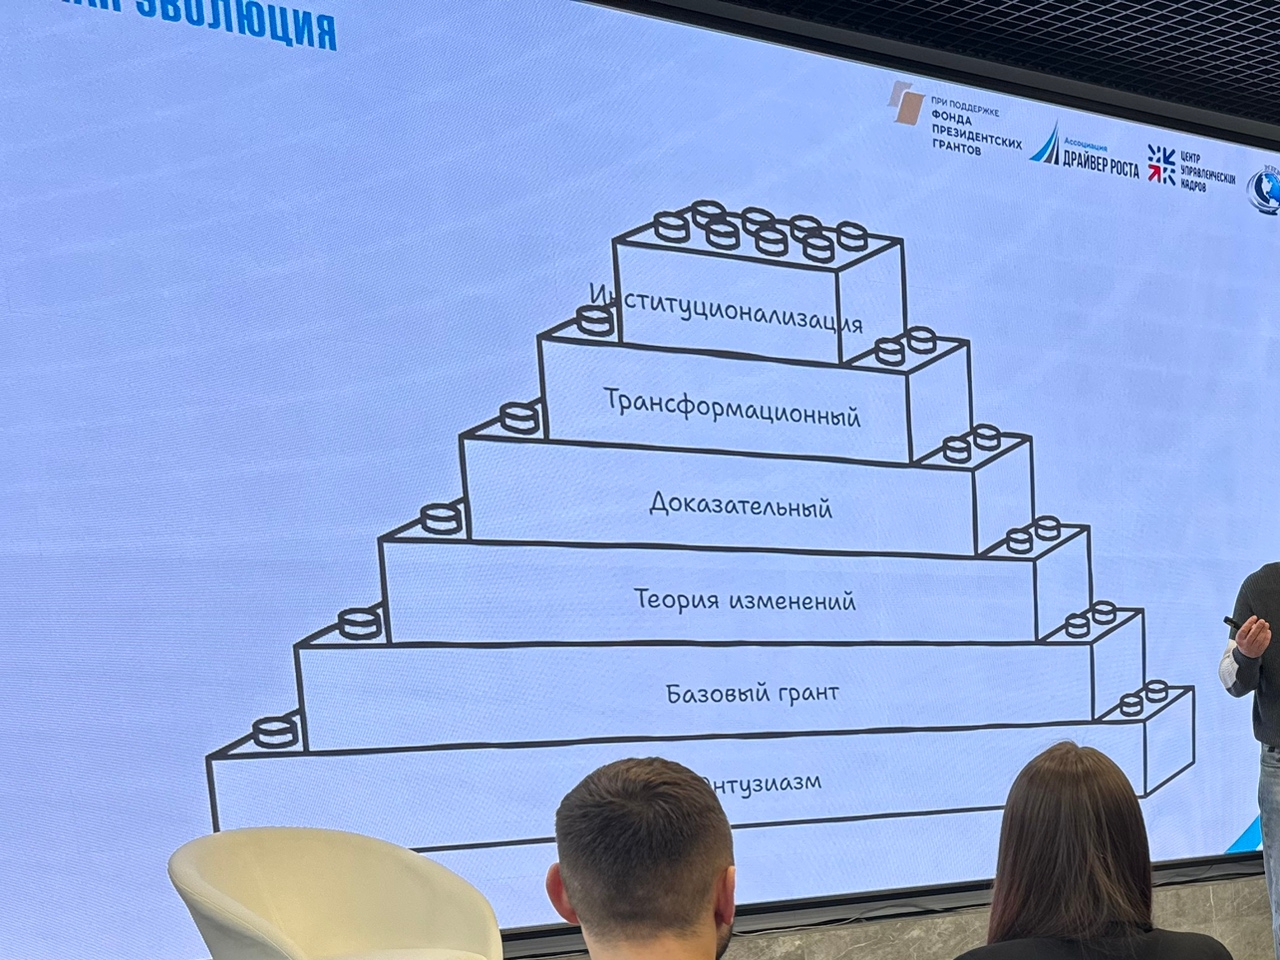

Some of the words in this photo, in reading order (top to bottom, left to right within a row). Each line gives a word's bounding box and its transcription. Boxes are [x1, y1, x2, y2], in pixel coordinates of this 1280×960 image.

[931, 96, 948, 107] ПРИ
[950, 100, 1000, 117] ПОДДЕРЖКЕ
[931, 109, 973, 126] ФОНДА
[932, 124, 1023, 150] ПРЕЗИДЕНТСКИХ
[932, 138, 982, 156] ГРАНТОВ
[1063, 149, 1109, 173] ДРАЙВЕР
[1110, 158, 1140, 179] РОСТА
[1180, 150, 1201, 164] ЦЕНТР
[1180, 177, 1207, 193] КАДРОВ
[603, 386, 862, 427] Трансформационный
[649, 490, 833, 519] Доказательный
[633, 587, 720, 615] Теория
[728, 590, 857, 611] изменений
[666, 681, 771, 704] Базовый
[778, 685, 840, 707] грант
[702, 775, 822, 799] нтузиазм
